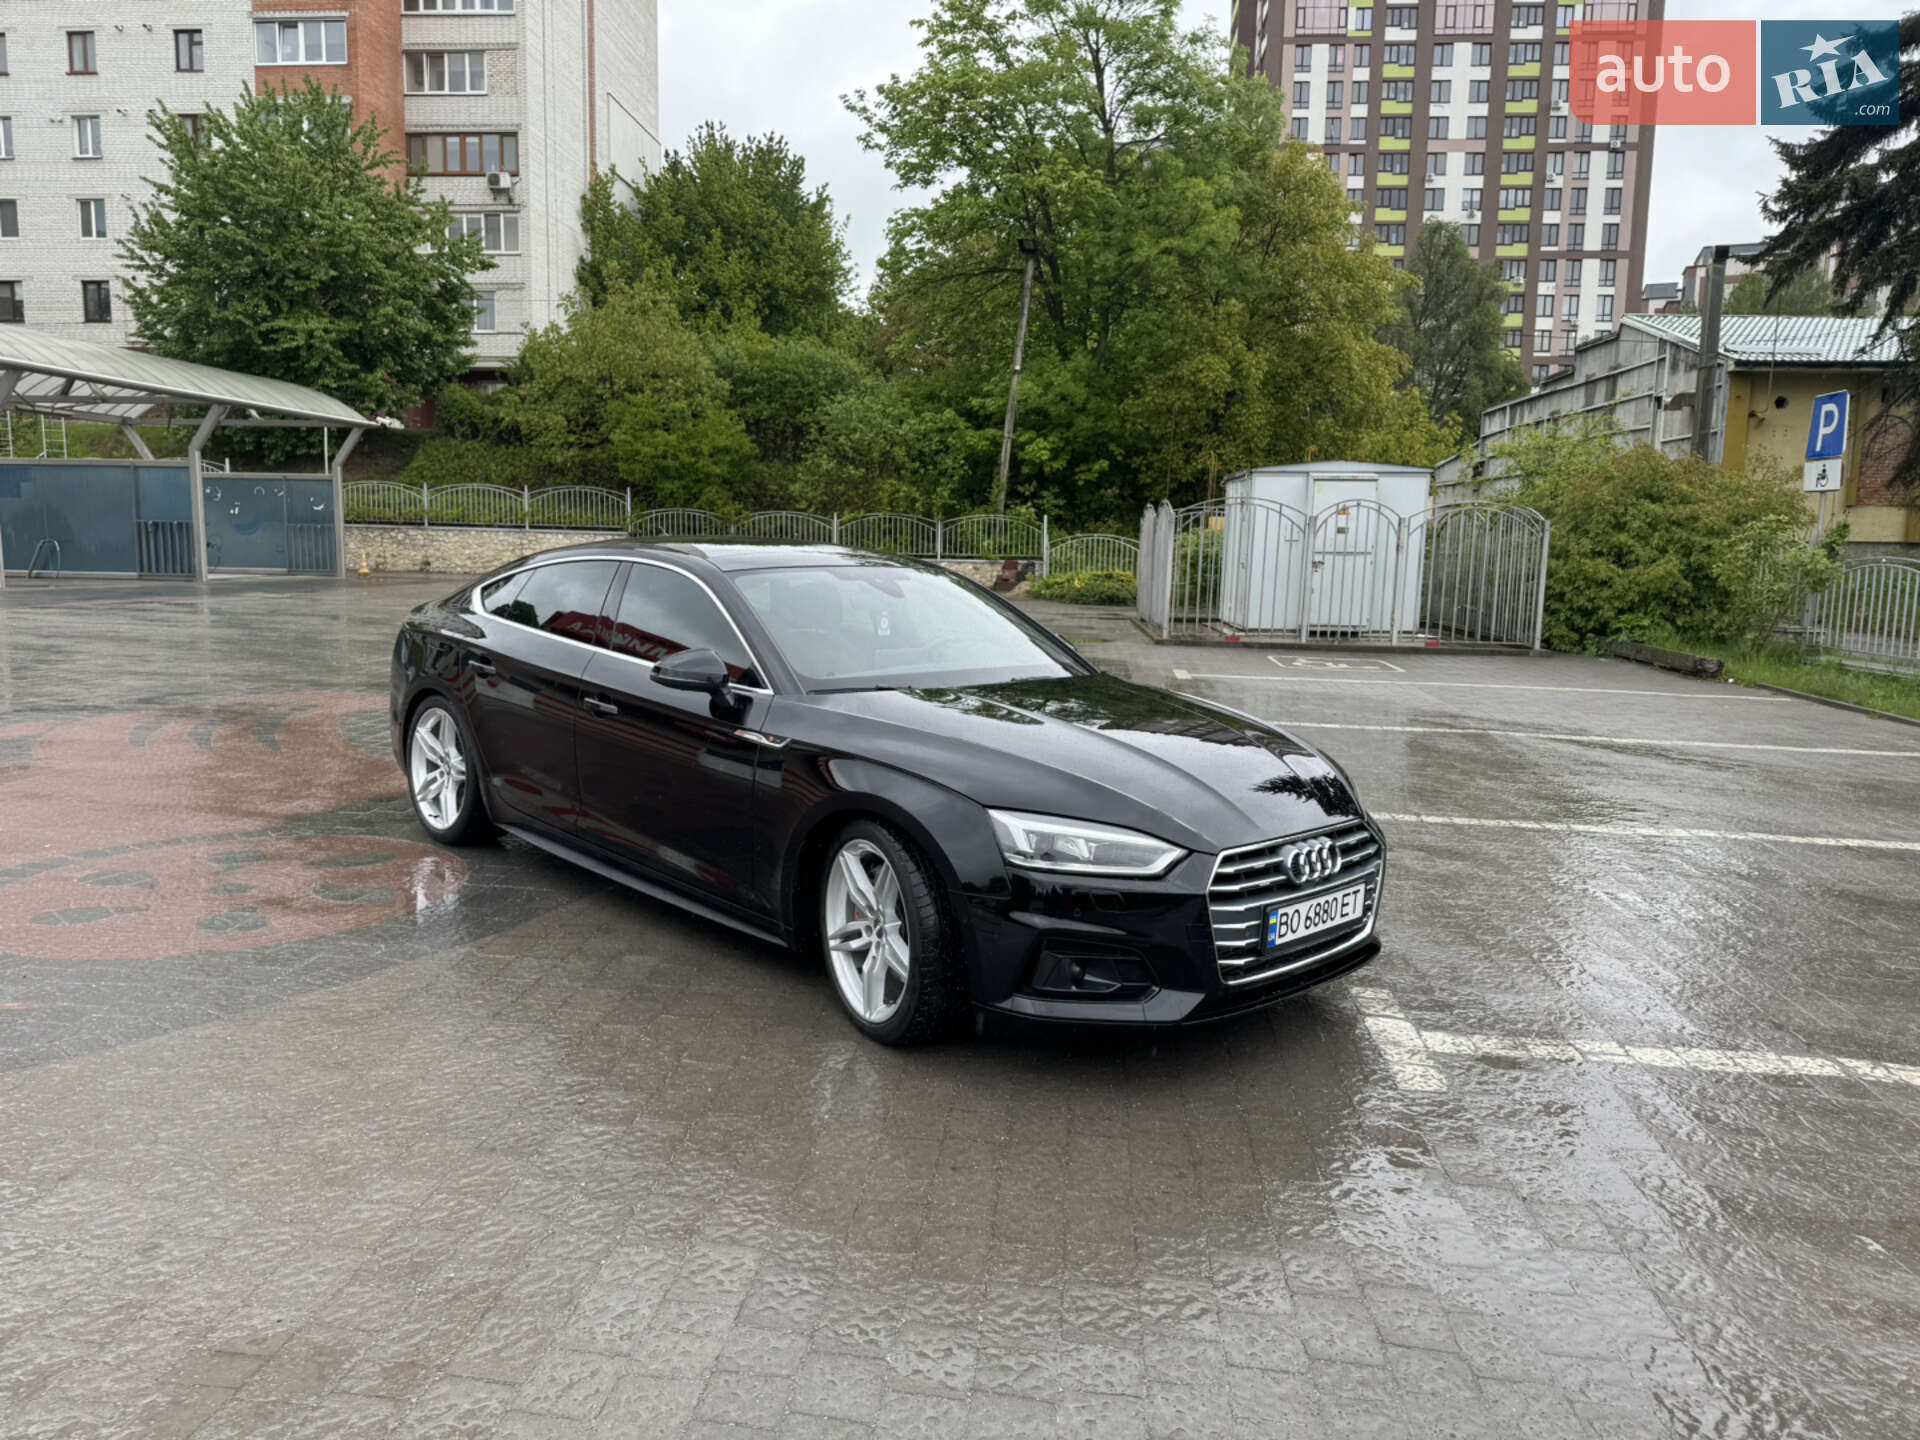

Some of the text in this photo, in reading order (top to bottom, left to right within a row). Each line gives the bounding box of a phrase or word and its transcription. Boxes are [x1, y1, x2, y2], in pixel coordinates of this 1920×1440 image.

[1816, 403, 1839, 452] P
[1278, 889, 1361, 938] BO 6880 ET
